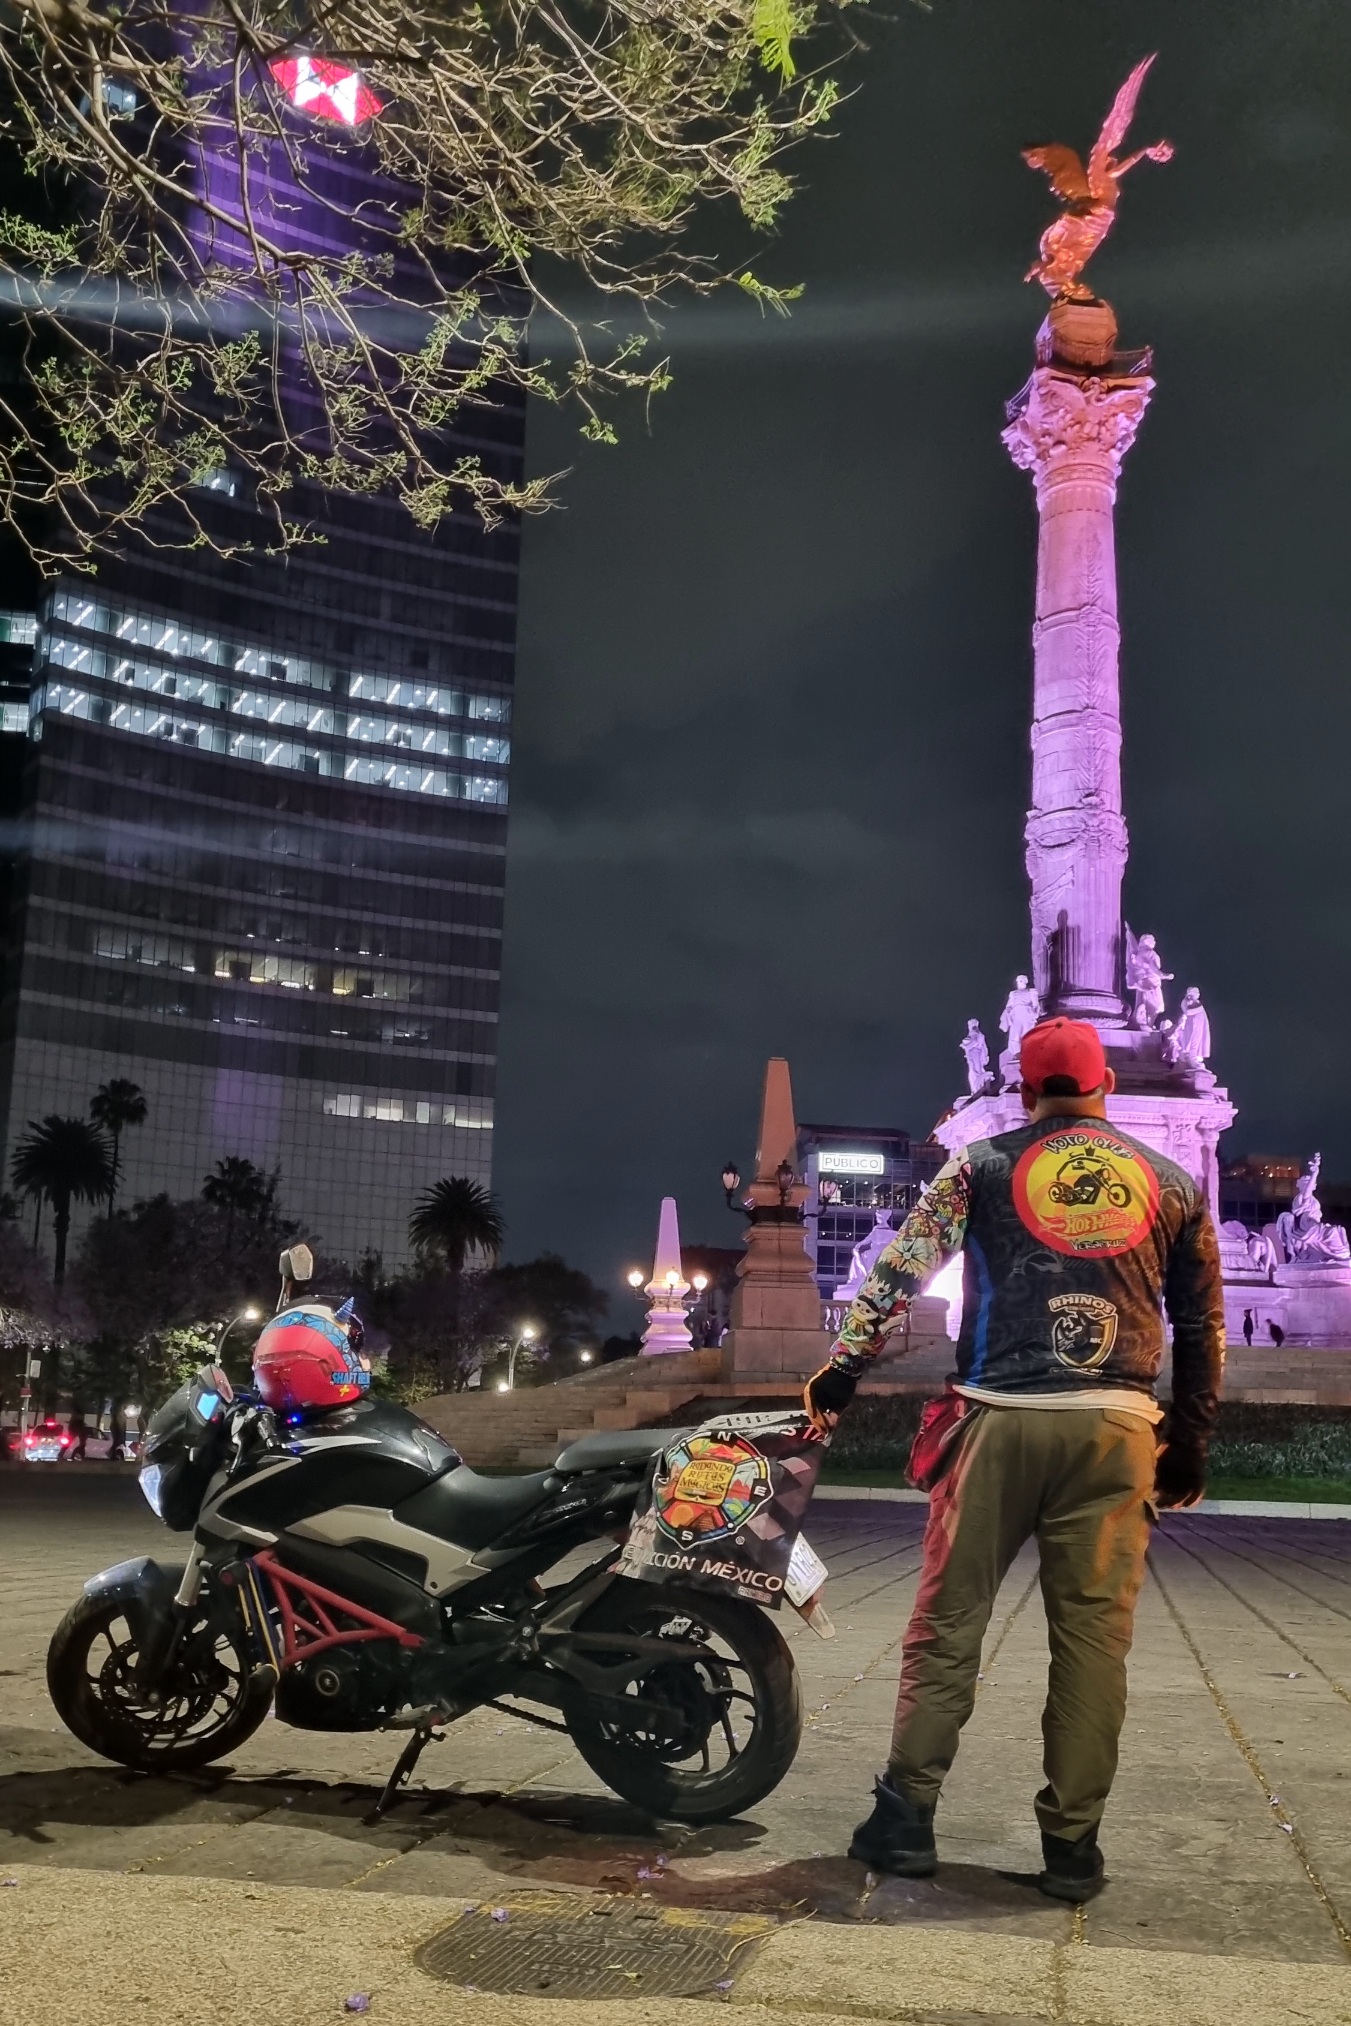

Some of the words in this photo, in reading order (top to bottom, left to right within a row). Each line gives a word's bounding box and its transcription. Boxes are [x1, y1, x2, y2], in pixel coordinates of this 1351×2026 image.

[825, 1157, 879, 1169] PUBLICO
[1050, 1295, 1114, 1314] RHINOS
[332, 1372, 358, 1385] SHAFT
[716, 1431, 732, 1442] N
[754, 1485, 767, 1497] E
[681, 1530, 694, 1541] S
[700, 1559, 784, 1592] MÉXICO
